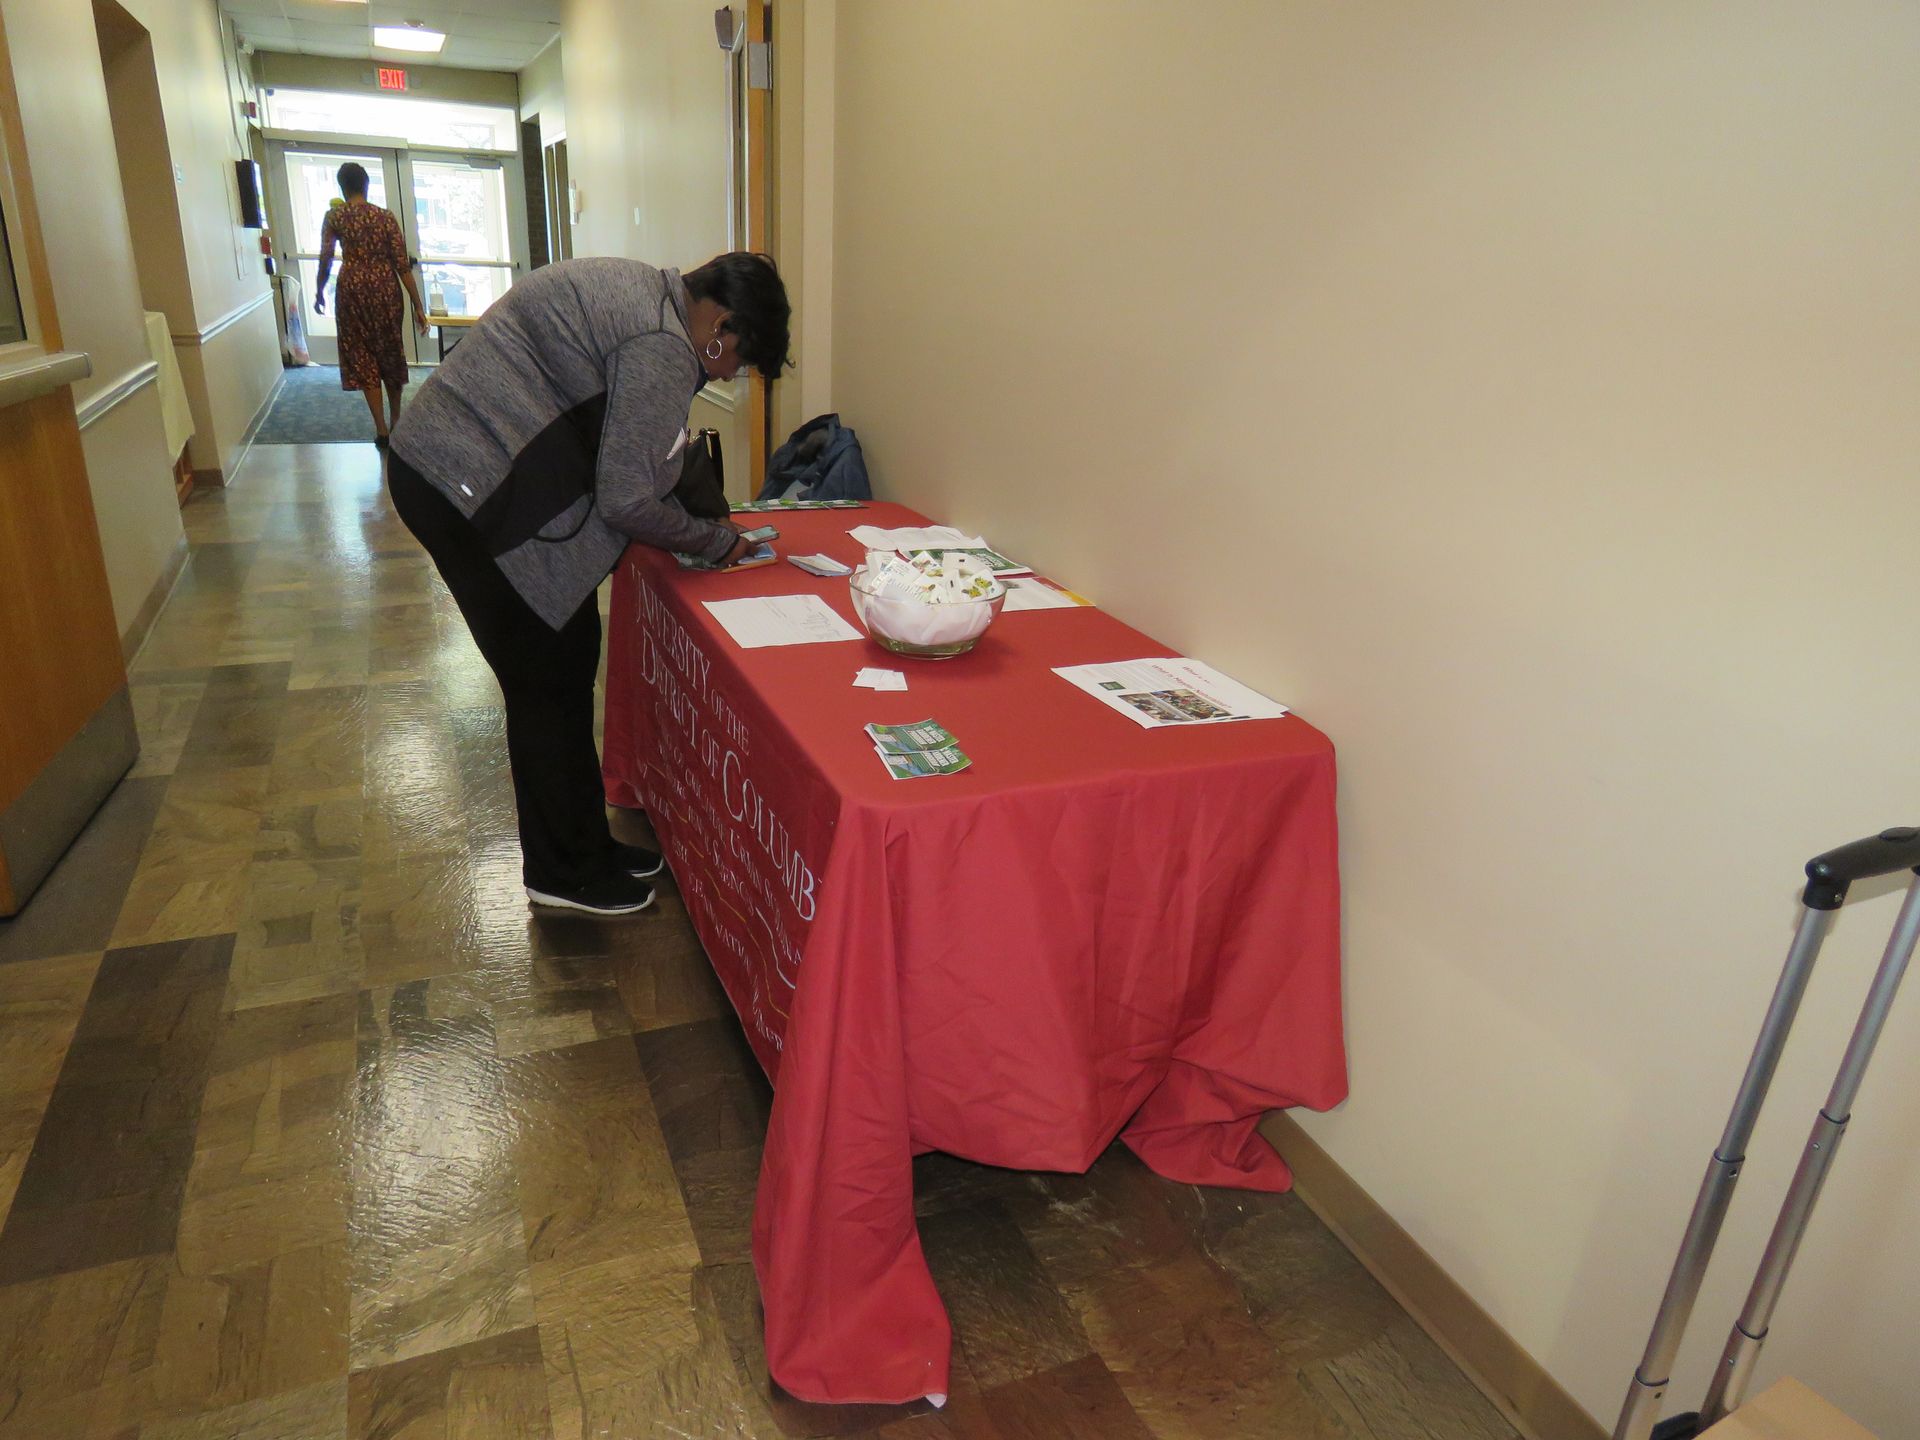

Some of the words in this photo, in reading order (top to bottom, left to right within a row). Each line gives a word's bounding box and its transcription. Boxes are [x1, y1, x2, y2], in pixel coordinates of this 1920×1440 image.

[379, 68, 405, 90] EXIT
[711, 688, 724, 721] OF
[726, 705, 750, 756] THE
[702, 728, 719, 779] OF
[723, 750, 815, 920] COLUMB
